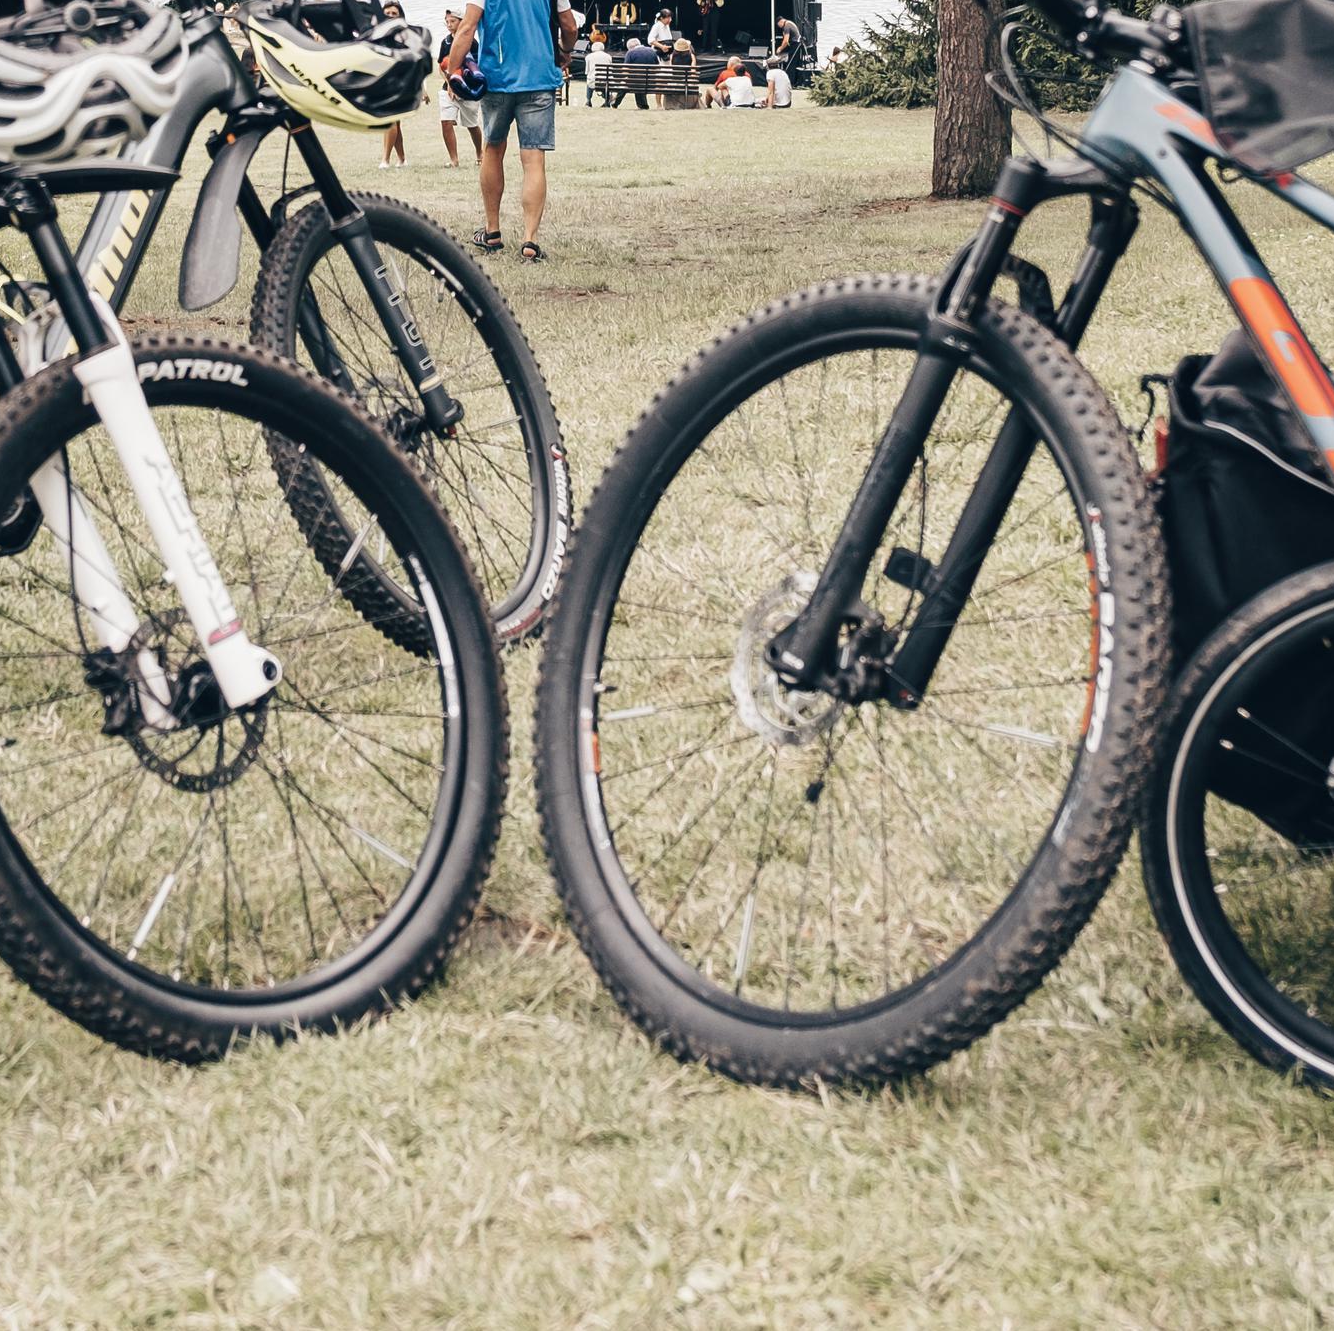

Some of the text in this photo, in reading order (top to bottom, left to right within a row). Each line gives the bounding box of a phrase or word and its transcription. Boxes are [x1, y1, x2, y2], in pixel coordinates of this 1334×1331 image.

[136, 358, 249, 388] PATROL
[540, 520, 568, 601] BARZO
[1084, 592, 1116, 754] BARZO
